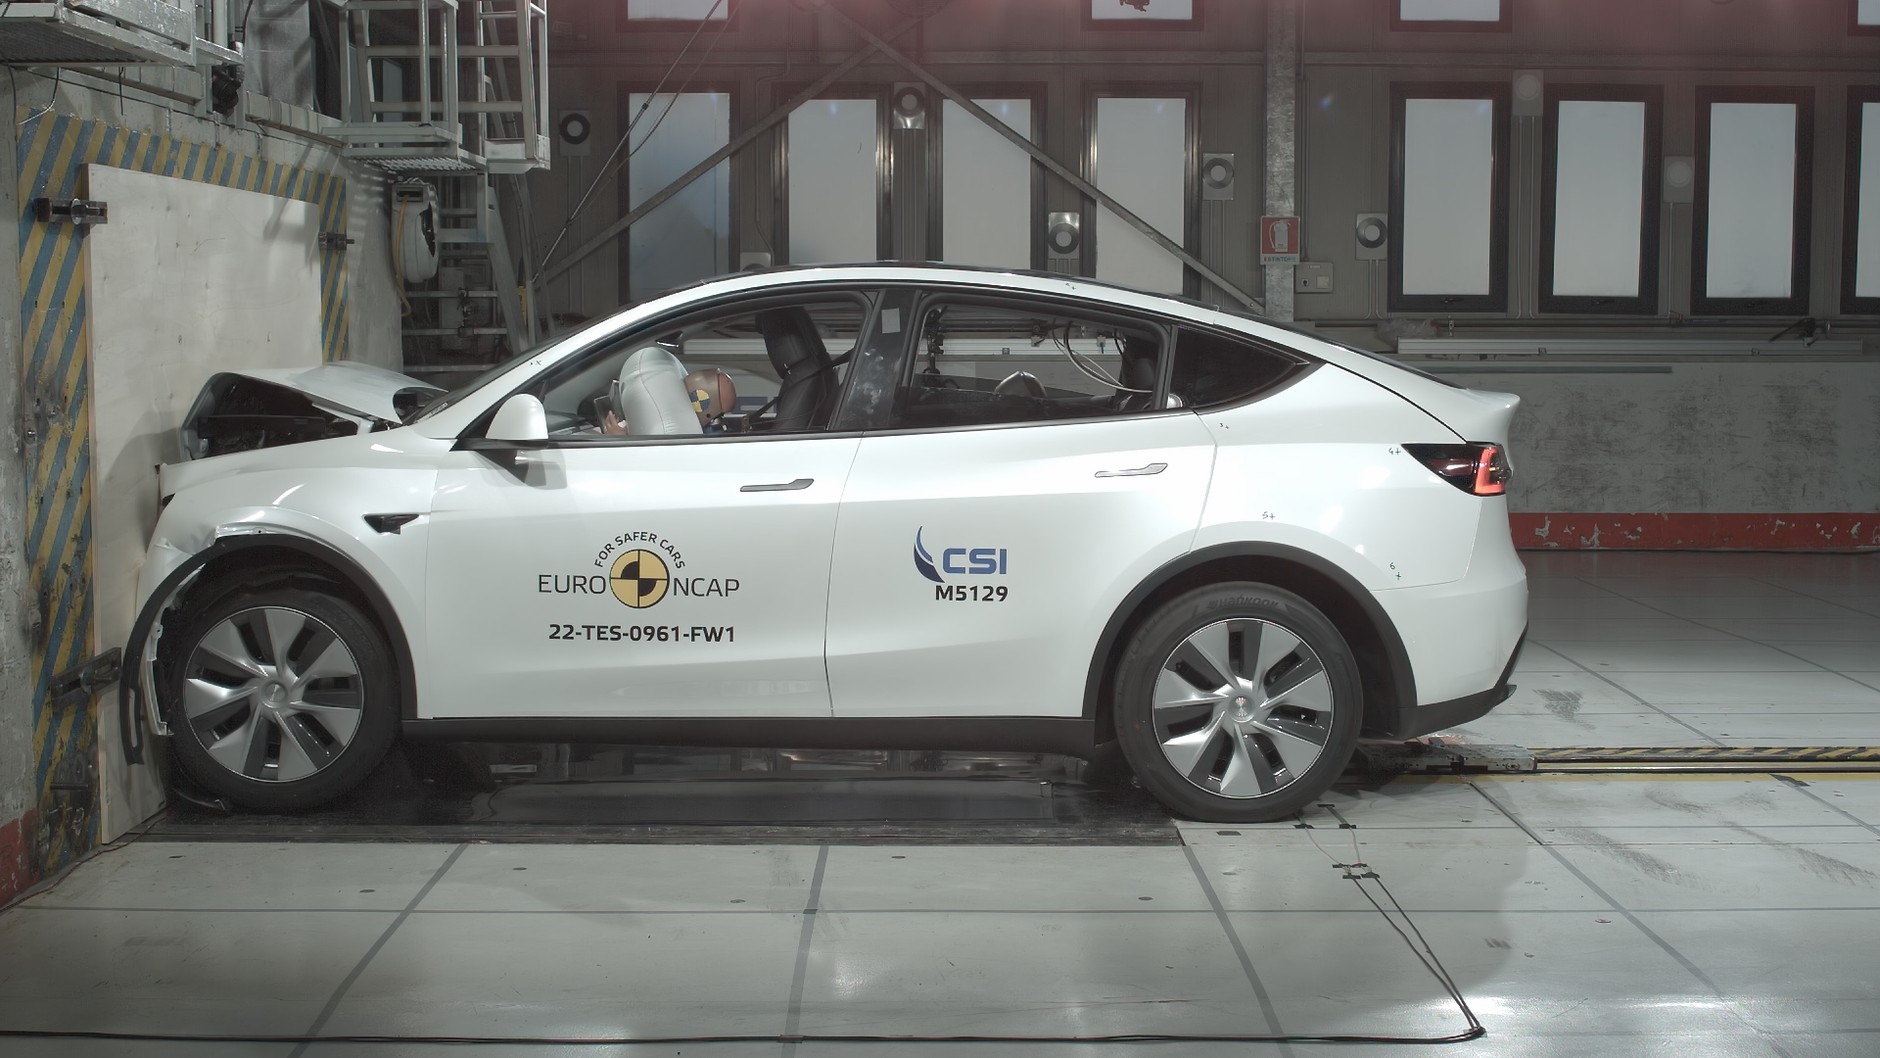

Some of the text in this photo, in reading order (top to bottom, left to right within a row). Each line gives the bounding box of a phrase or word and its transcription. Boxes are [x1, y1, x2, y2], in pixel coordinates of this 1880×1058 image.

[594, 531, 686, 569] FOR SAFER CARS
[942, 547, 1007, 575] CSI
[538, 574, 740, 597] EURO NCAP
[935, 584, 1009, 602] M5129
[548, 623, 735, 643] 22-TES-0961-FW1
